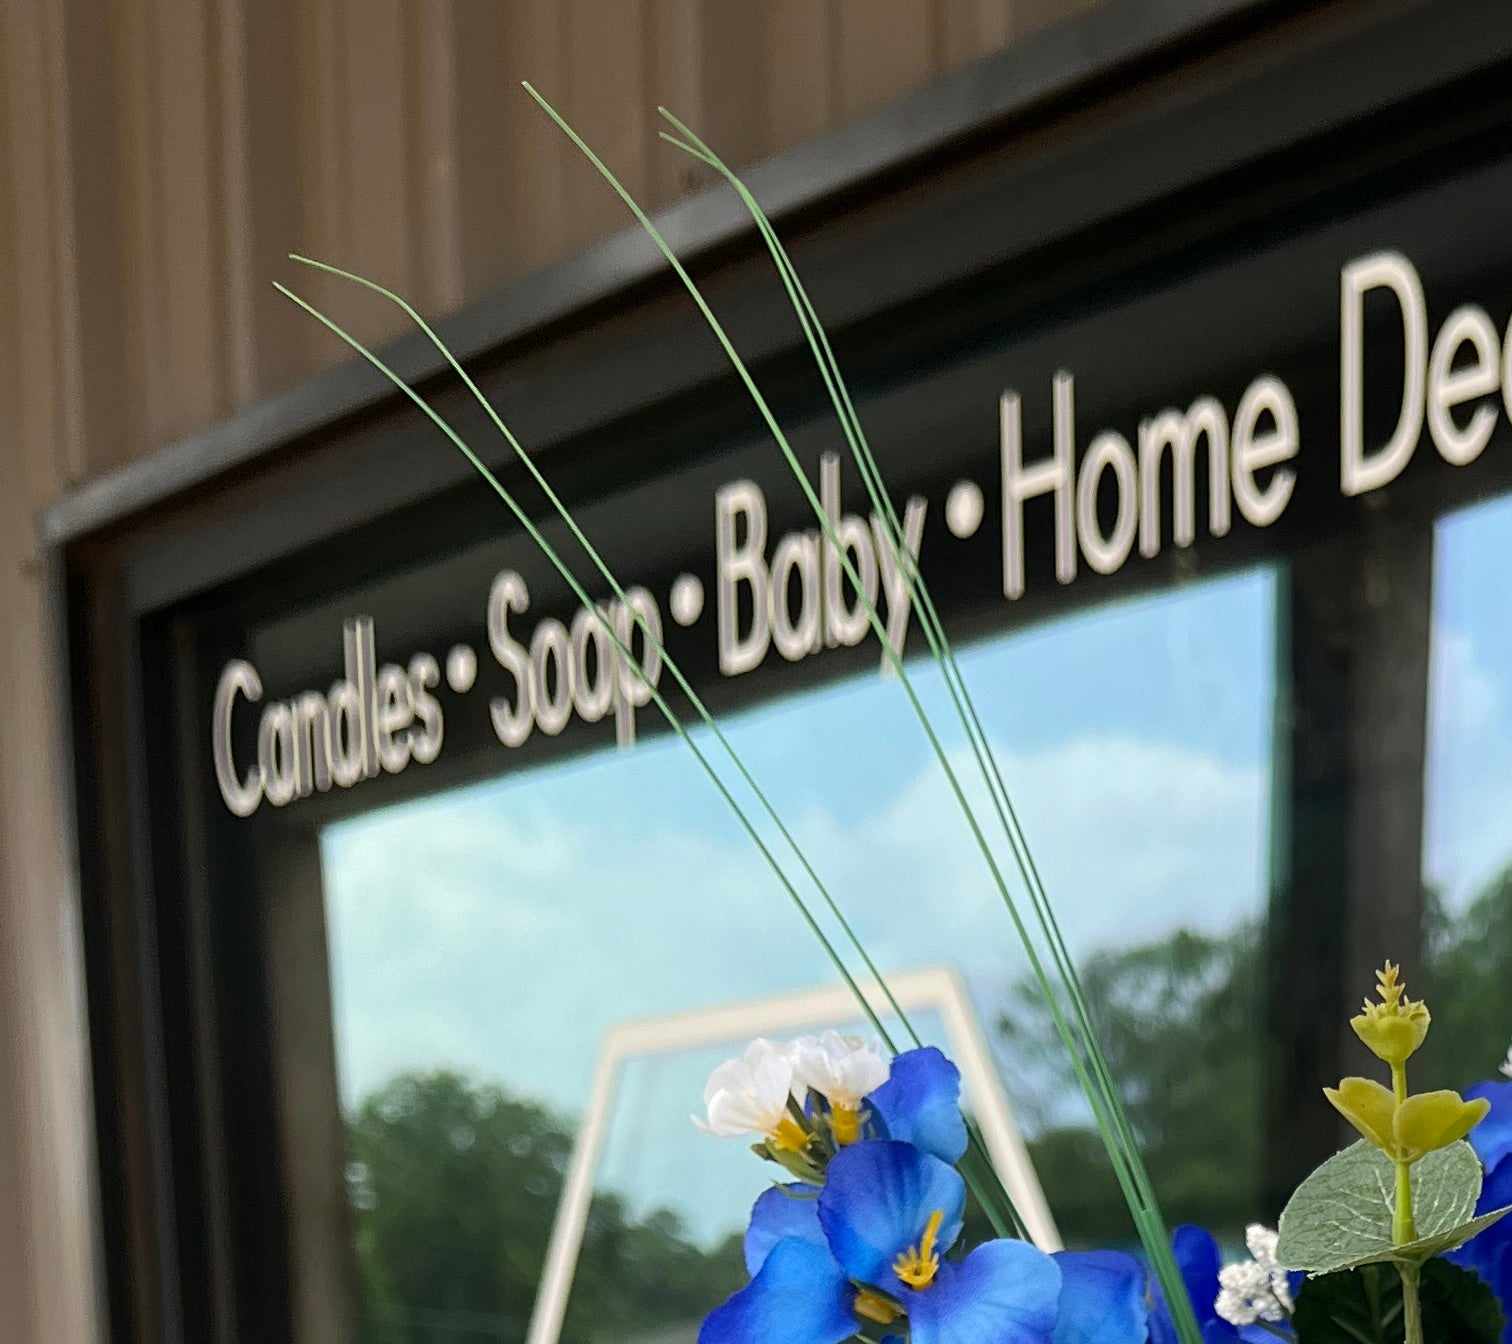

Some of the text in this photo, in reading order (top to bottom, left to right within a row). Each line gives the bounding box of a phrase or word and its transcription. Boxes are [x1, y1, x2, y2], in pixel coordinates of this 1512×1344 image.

[213, 614, 445, 817] Candles
[488, 569, 664, 748] Soap
[715, 443, 929, 679] Baby
[1000, 369, 1299, 600] Home
